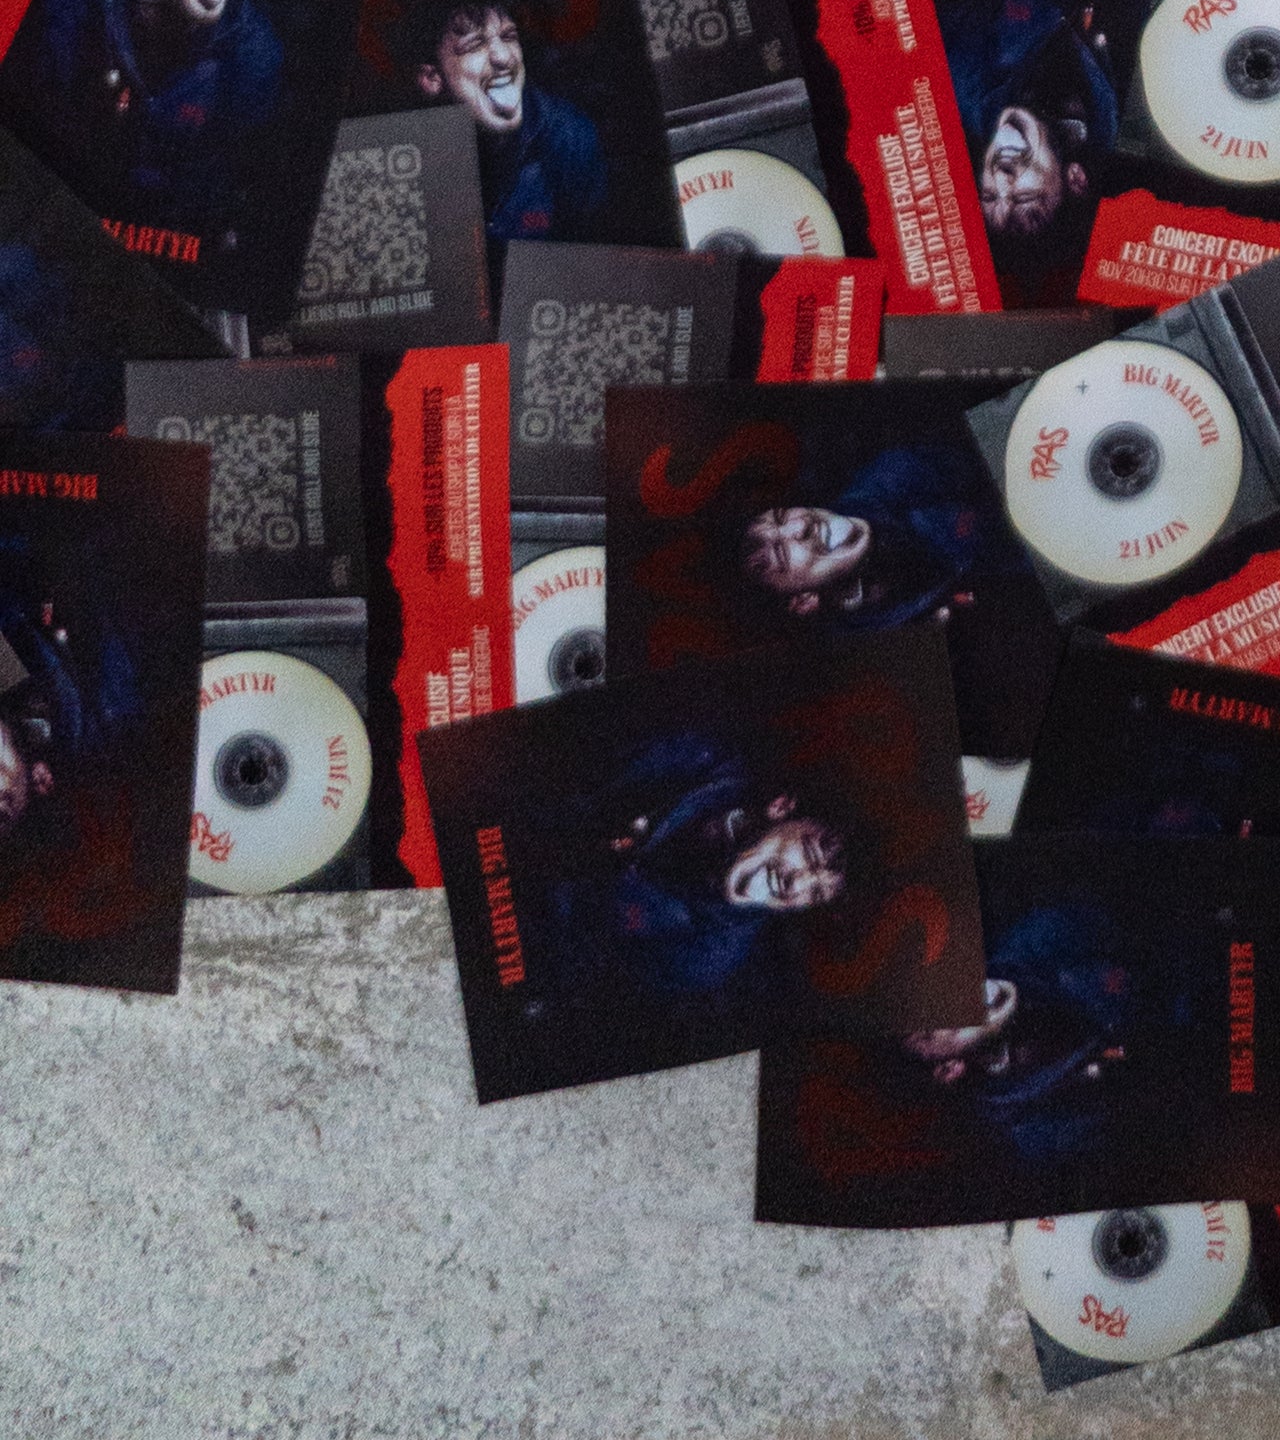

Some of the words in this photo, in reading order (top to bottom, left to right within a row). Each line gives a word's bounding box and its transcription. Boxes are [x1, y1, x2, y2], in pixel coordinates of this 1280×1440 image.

[874, 129, 914, 210] EXCLUSIF
[1199, 126, 1224, 151] 21
[1219, 137, 1270, 162] JUIN
[892, 207, 931, 287] CONCERT
[475, 825, 508, 872] BIG
[482, 876, 528, 986] MARTYR
